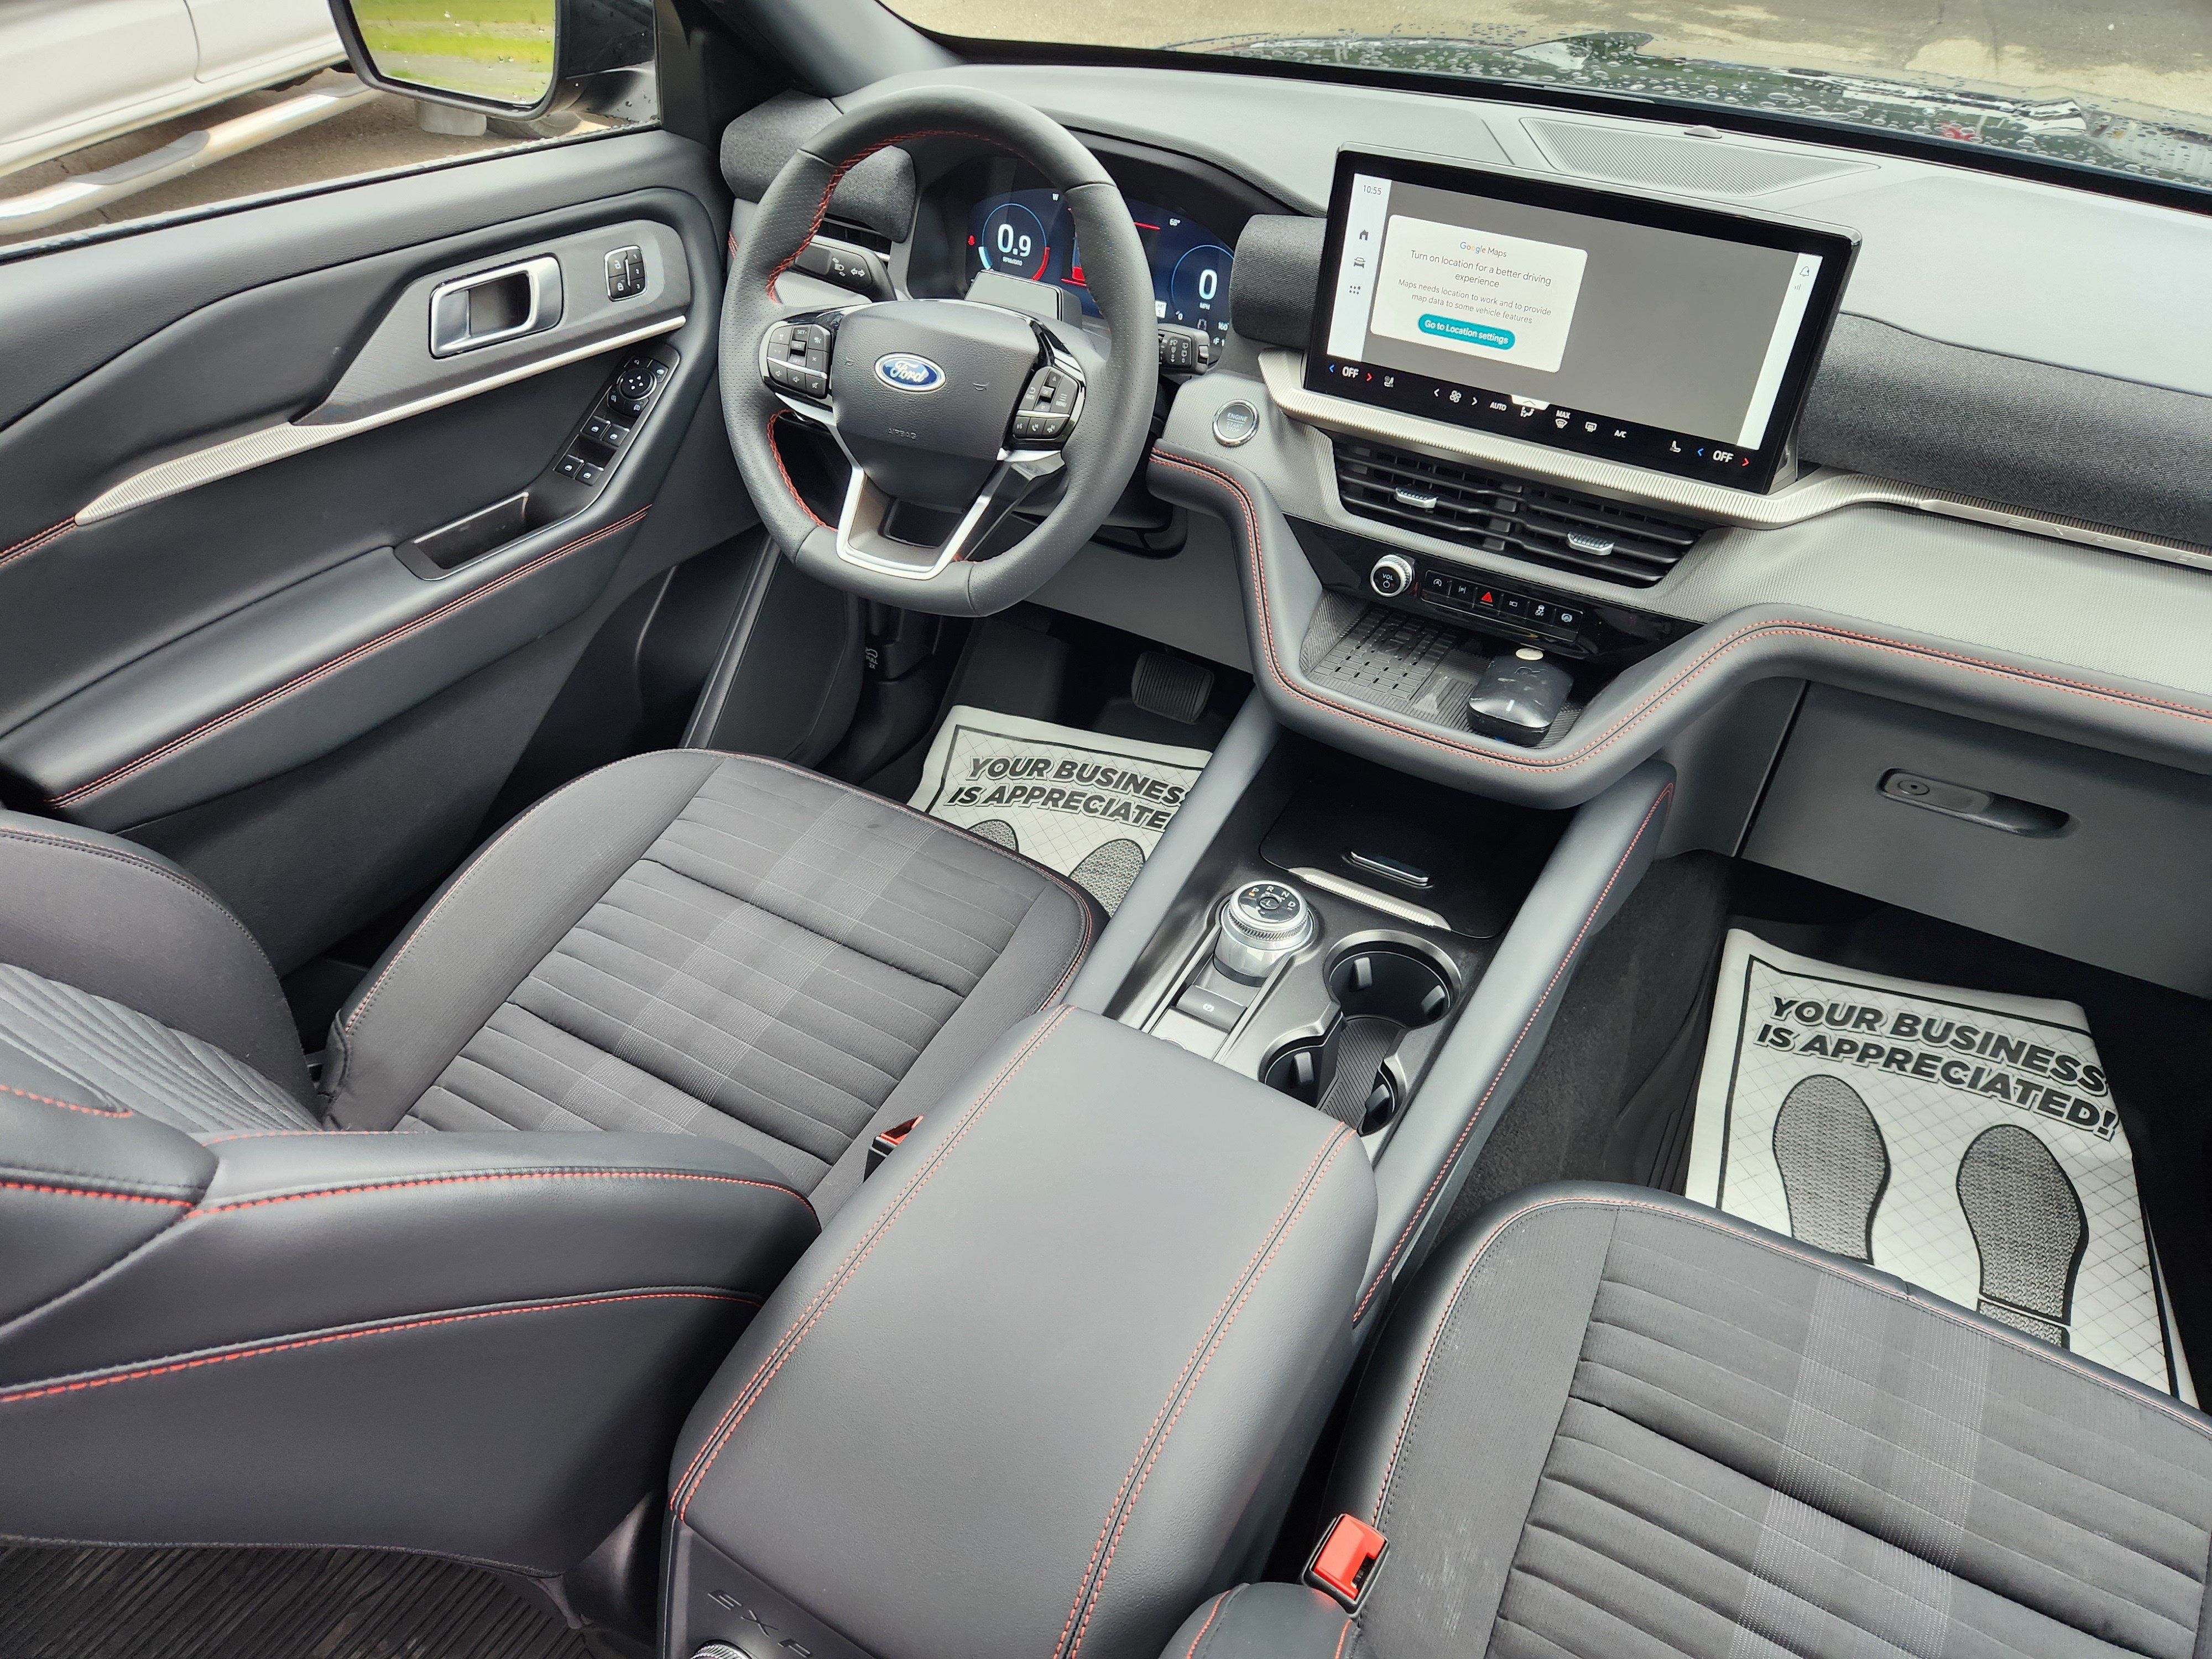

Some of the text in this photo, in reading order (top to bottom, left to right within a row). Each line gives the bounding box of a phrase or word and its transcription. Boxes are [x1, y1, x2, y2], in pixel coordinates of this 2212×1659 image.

[1363, 185, 1381, 195] 10:55
[997, 223, 1031, 257] 0.9
[1459, 242, 1507, 258] Google Maps
[1411, 250, 1427, 260] Turn
[1441, 255, 1473, 269] location
[1475, 263, 1488, 272] for
[1496, 266, 1521, 279] better
[1522, 272, 1551, 286] driving
[1199, 269, 1217, 300] 0
[1455, 274, 1500, 288] experience
[1199, 302, 1211, 310] MPH
[1398, 279, 1417, 289] Maps
[1418, 283, 1439, 293] needs
[1441, 286, 1469, 300] location
[1471, 293, 1478, 301] to
[1480, 295, 1498, 305] work
[1499, 299, 1514, 308] and
[1524, 304, 1552, 316] provide
[1411, 294, 1427, 303] map
[1428, 296, 1444, 306] data
[1455, 302, 1474, 311] some
[1476, 306, 1500, 317] vehicle
[1503, 311, 1533, 324] features
[1425, 319, 1509, 345] Go to Location settings
[890, 361, 929, 383] Ford
[1342, 366, 1359, 379] OFF
[1227, 412, 1248, 422] ENGINE
[1489, 401, 1507, 411] AUTO
[1556, 410, 1571, 419] MAX
[1614, 429, 1627, 439] A/C
[1713, 450, 1734, 463] OFF
[967, 755, 1188, 807] YOUR BUSINES
[945, 784, 1176, 832] IS APPRECIATE
[1771, 995, 2110, 1097] YOUR BUSINESS
[1756, 1022, 2120, 1141] IS APPRECIATED!
